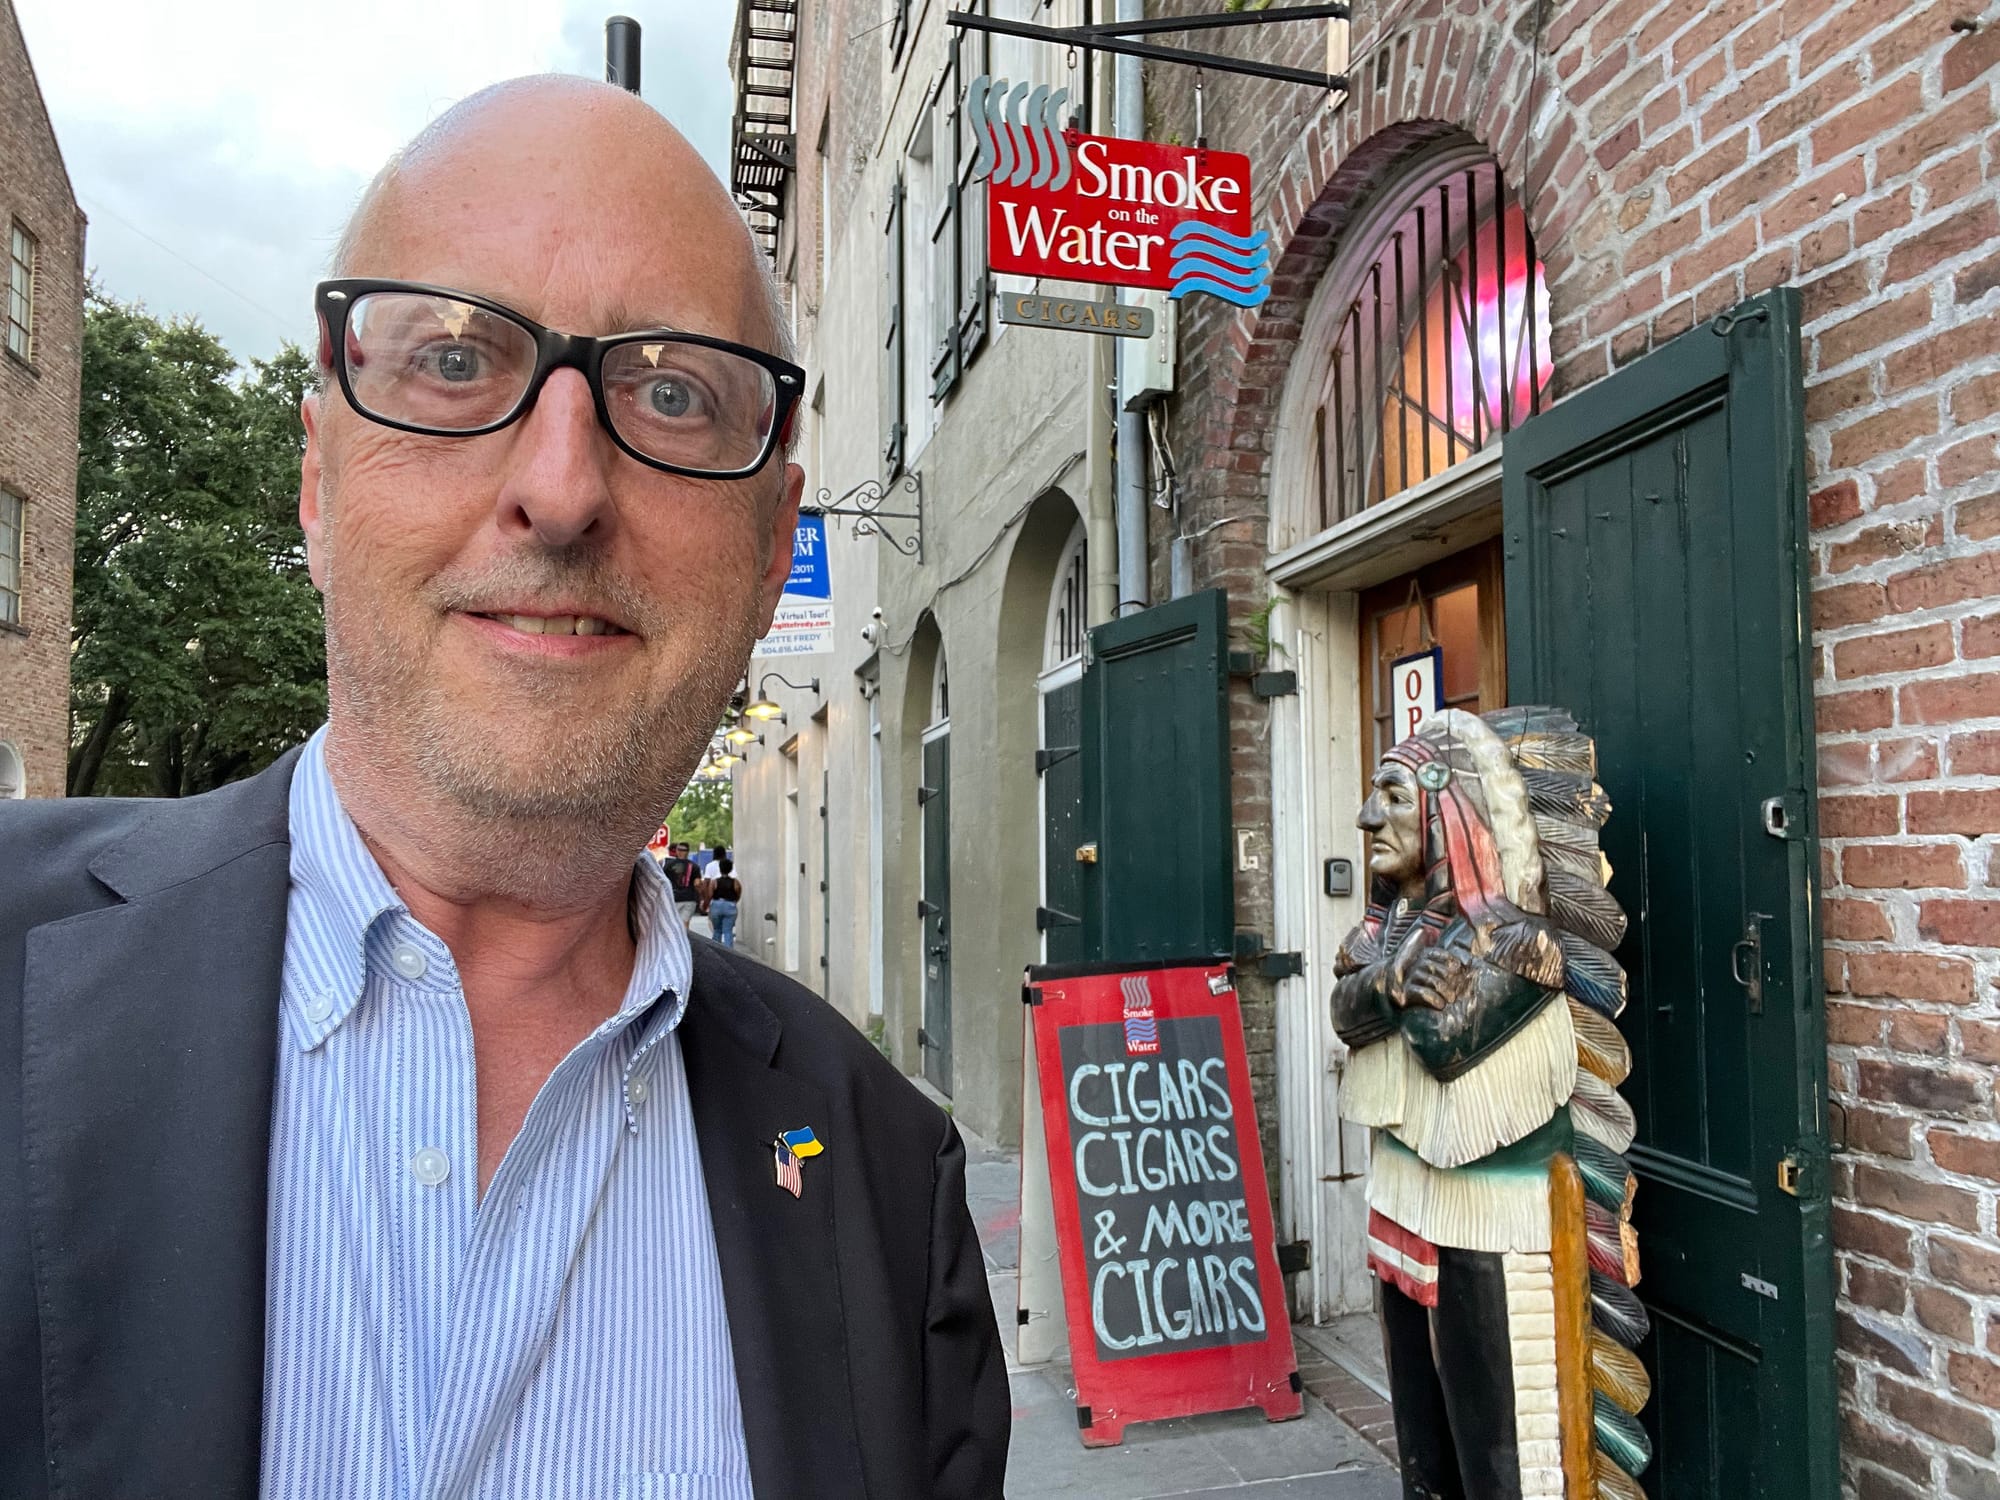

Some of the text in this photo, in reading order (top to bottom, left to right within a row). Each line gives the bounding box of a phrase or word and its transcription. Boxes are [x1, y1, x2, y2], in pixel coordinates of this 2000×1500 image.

[1076, 141, 1240, 215] Smoke
[998, 201, 1165, 271] Water
[1108, 208, 1159, 225] on the
[1015, 297, 1143, 331] CIGARS
[781, 610, 807, 620] Virtual
[794, 633, 821, 642] FREDY
[1123, 1007, 1154, 1019] Smoke
[1127, 1039, 1158, 1052] Water
[1069, 1058, 1234, 1127] CIGARS
[1075, 1124, 1237, 1197] CIGARS
[1093, 1199, 1253, 1260] & MORE
[1092, 1254, 1266, 1350] CIGARS
